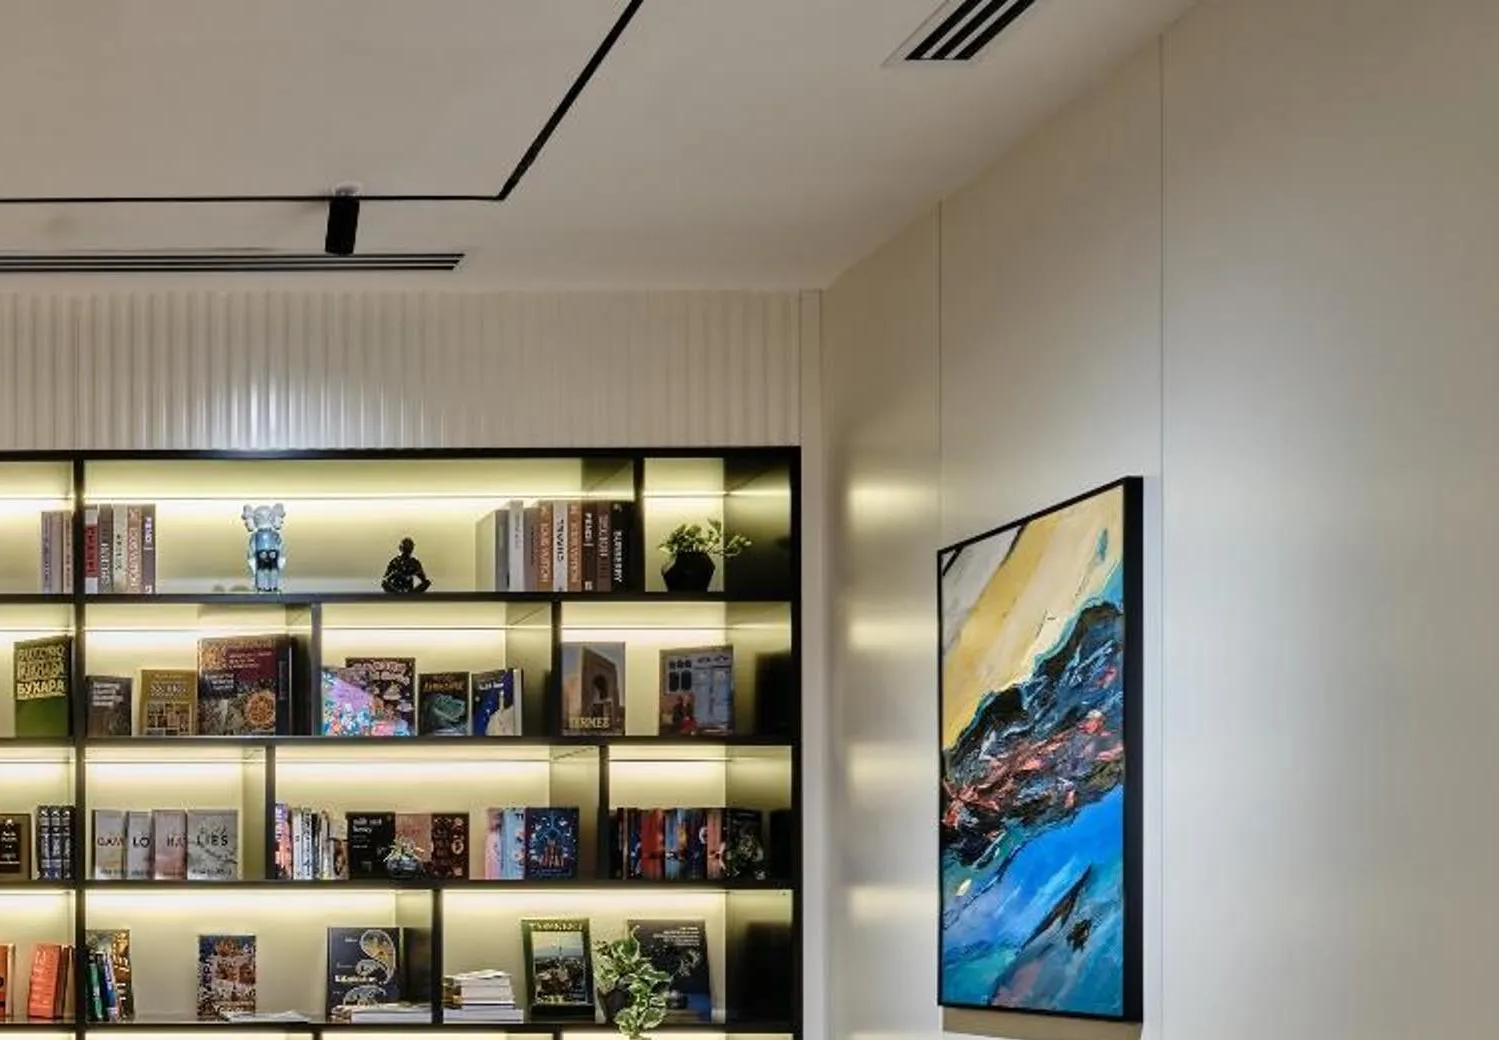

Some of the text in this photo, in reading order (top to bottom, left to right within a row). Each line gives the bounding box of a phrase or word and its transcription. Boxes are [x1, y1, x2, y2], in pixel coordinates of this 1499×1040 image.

[17, 680, 65, 694] БУХАРА
[133, 837, 150, 848] LO
[197, 835, 228, 847] LIES
